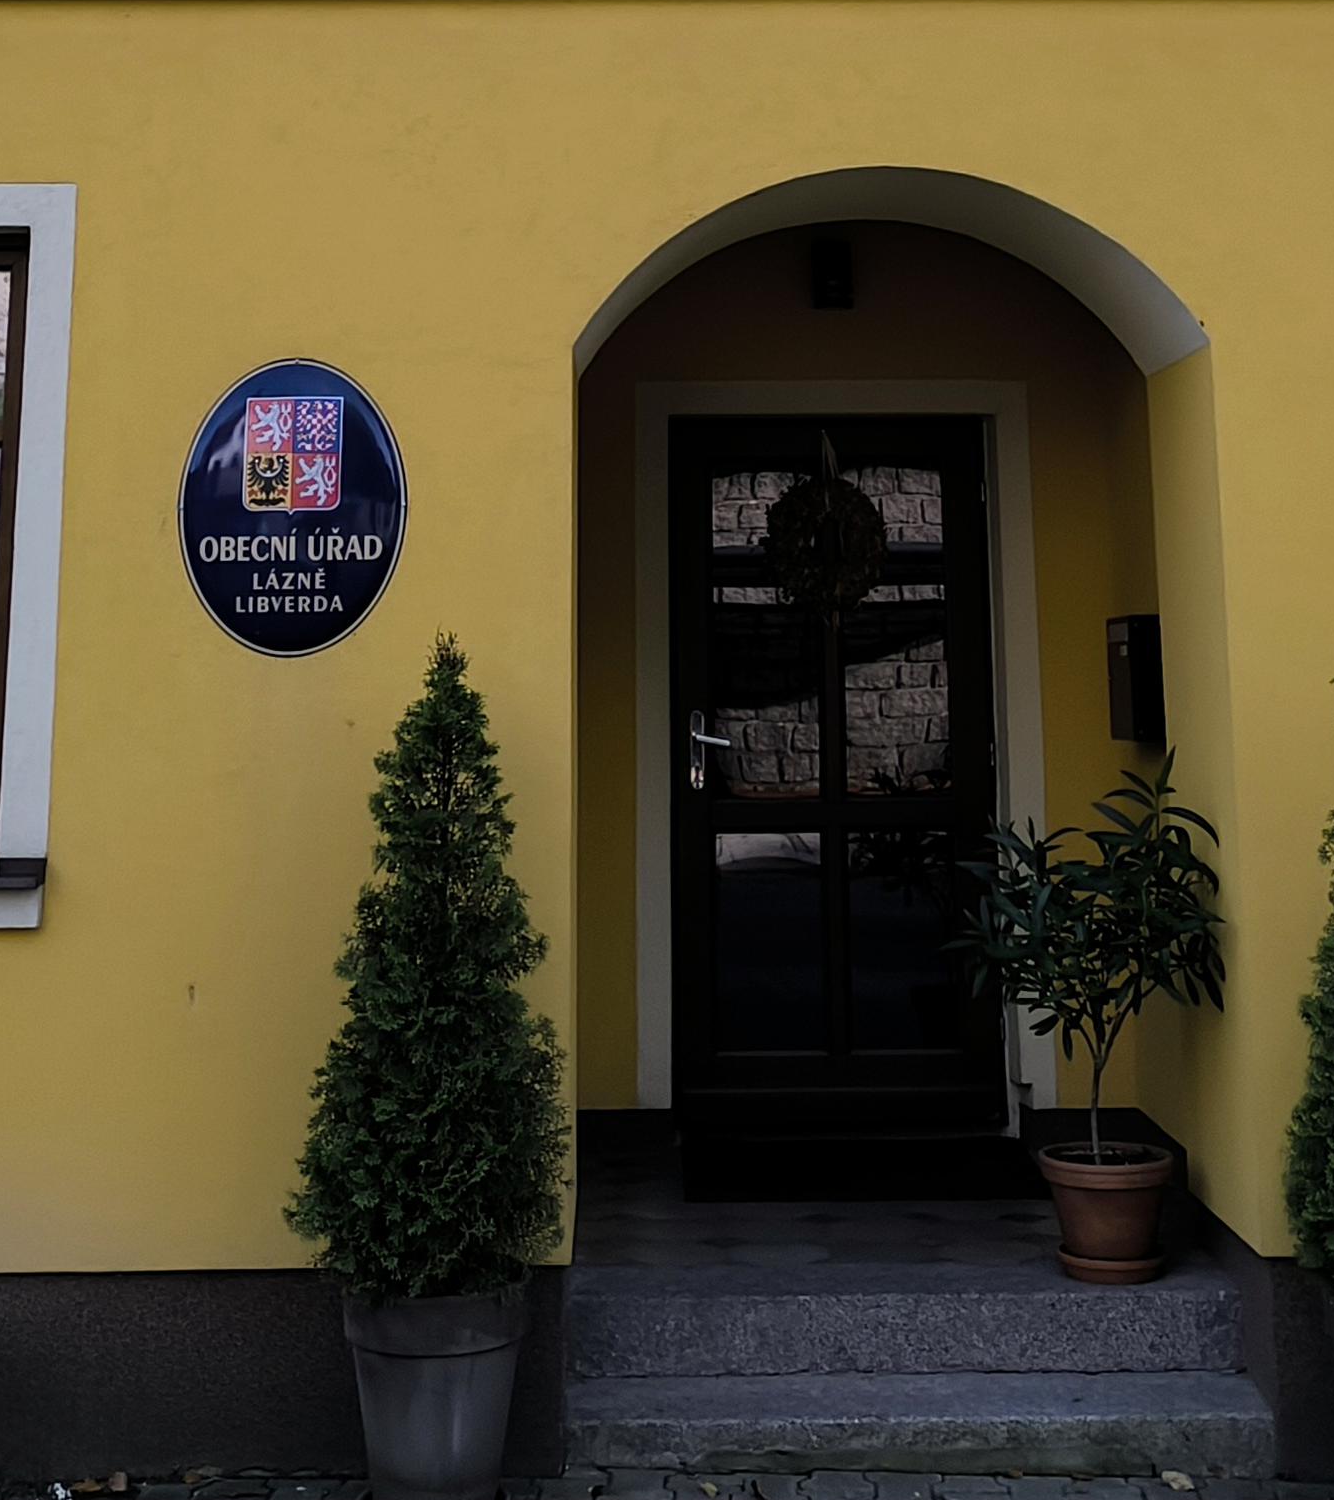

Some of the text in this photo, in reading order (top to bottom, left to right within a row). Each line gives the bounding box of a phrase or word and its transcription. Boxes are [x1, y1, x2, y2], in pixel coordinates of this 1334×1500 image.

[199, 527, 383, 562] OBECNÍ ÚŘAD
[252, 568, 326, 590] LÁZNĚ
[235, 595, 343, 613] LIBVERDA
